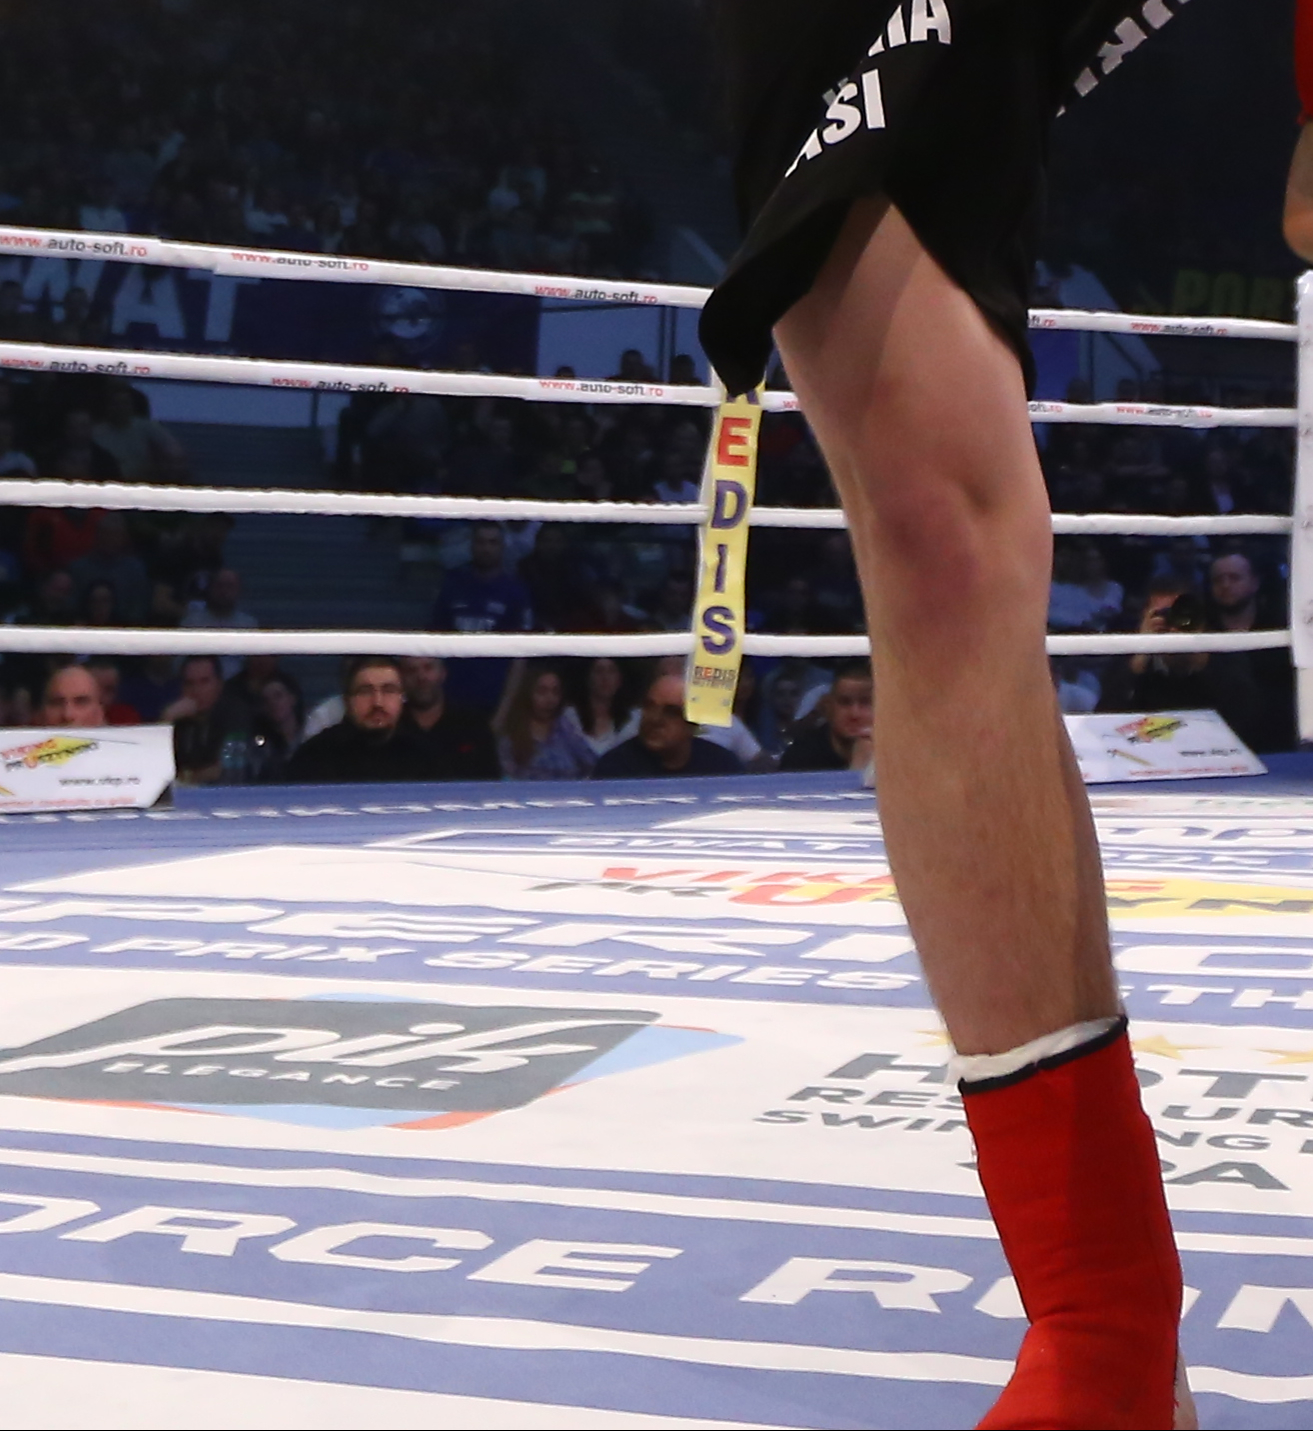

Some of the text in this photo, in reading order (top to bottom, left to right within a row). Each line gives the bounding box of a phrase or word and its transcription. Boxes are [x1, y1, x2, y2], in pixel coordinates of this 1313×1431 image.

[702, 390, 760, 656] EDIS
[90, 936, 418, 963] PRIX
[423, 949, 914, 990] SERIES
[102, 1061, 464, 1092] ELEGANCE
